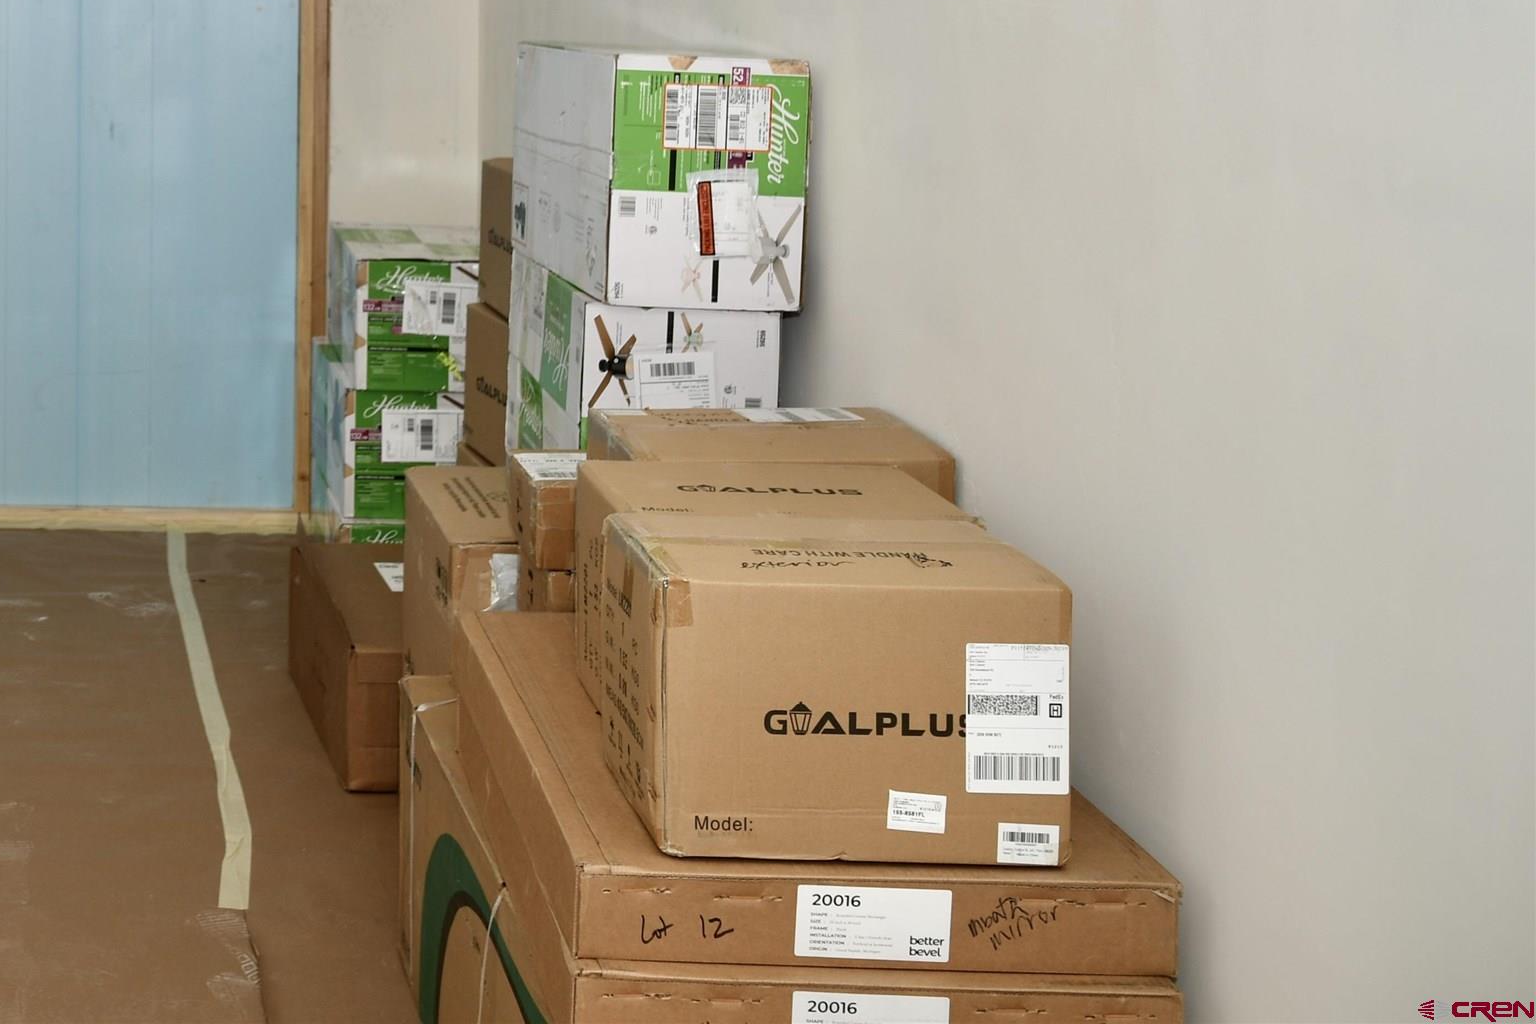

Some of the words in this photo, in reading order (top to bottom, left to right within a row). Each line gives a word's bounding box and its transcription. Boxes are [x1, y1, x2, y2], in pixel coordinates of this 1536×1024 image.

[733, 67, 744, 82] 52
[766, 84, 801, 185] Hunter
[751, 548, 800, 557] CARE
[805, 549, 851, 558] WITH
[694, 815, 753, 832] Model:
[812, 893, 861, 908] 20016
[641, 914, 674, 944] Lot
[699, 914, 734, 939] 12
[909, 935, 945, 946] better
[908, 946, 942, 957] bevel
[807, 1000, 858, 1015] 20016
